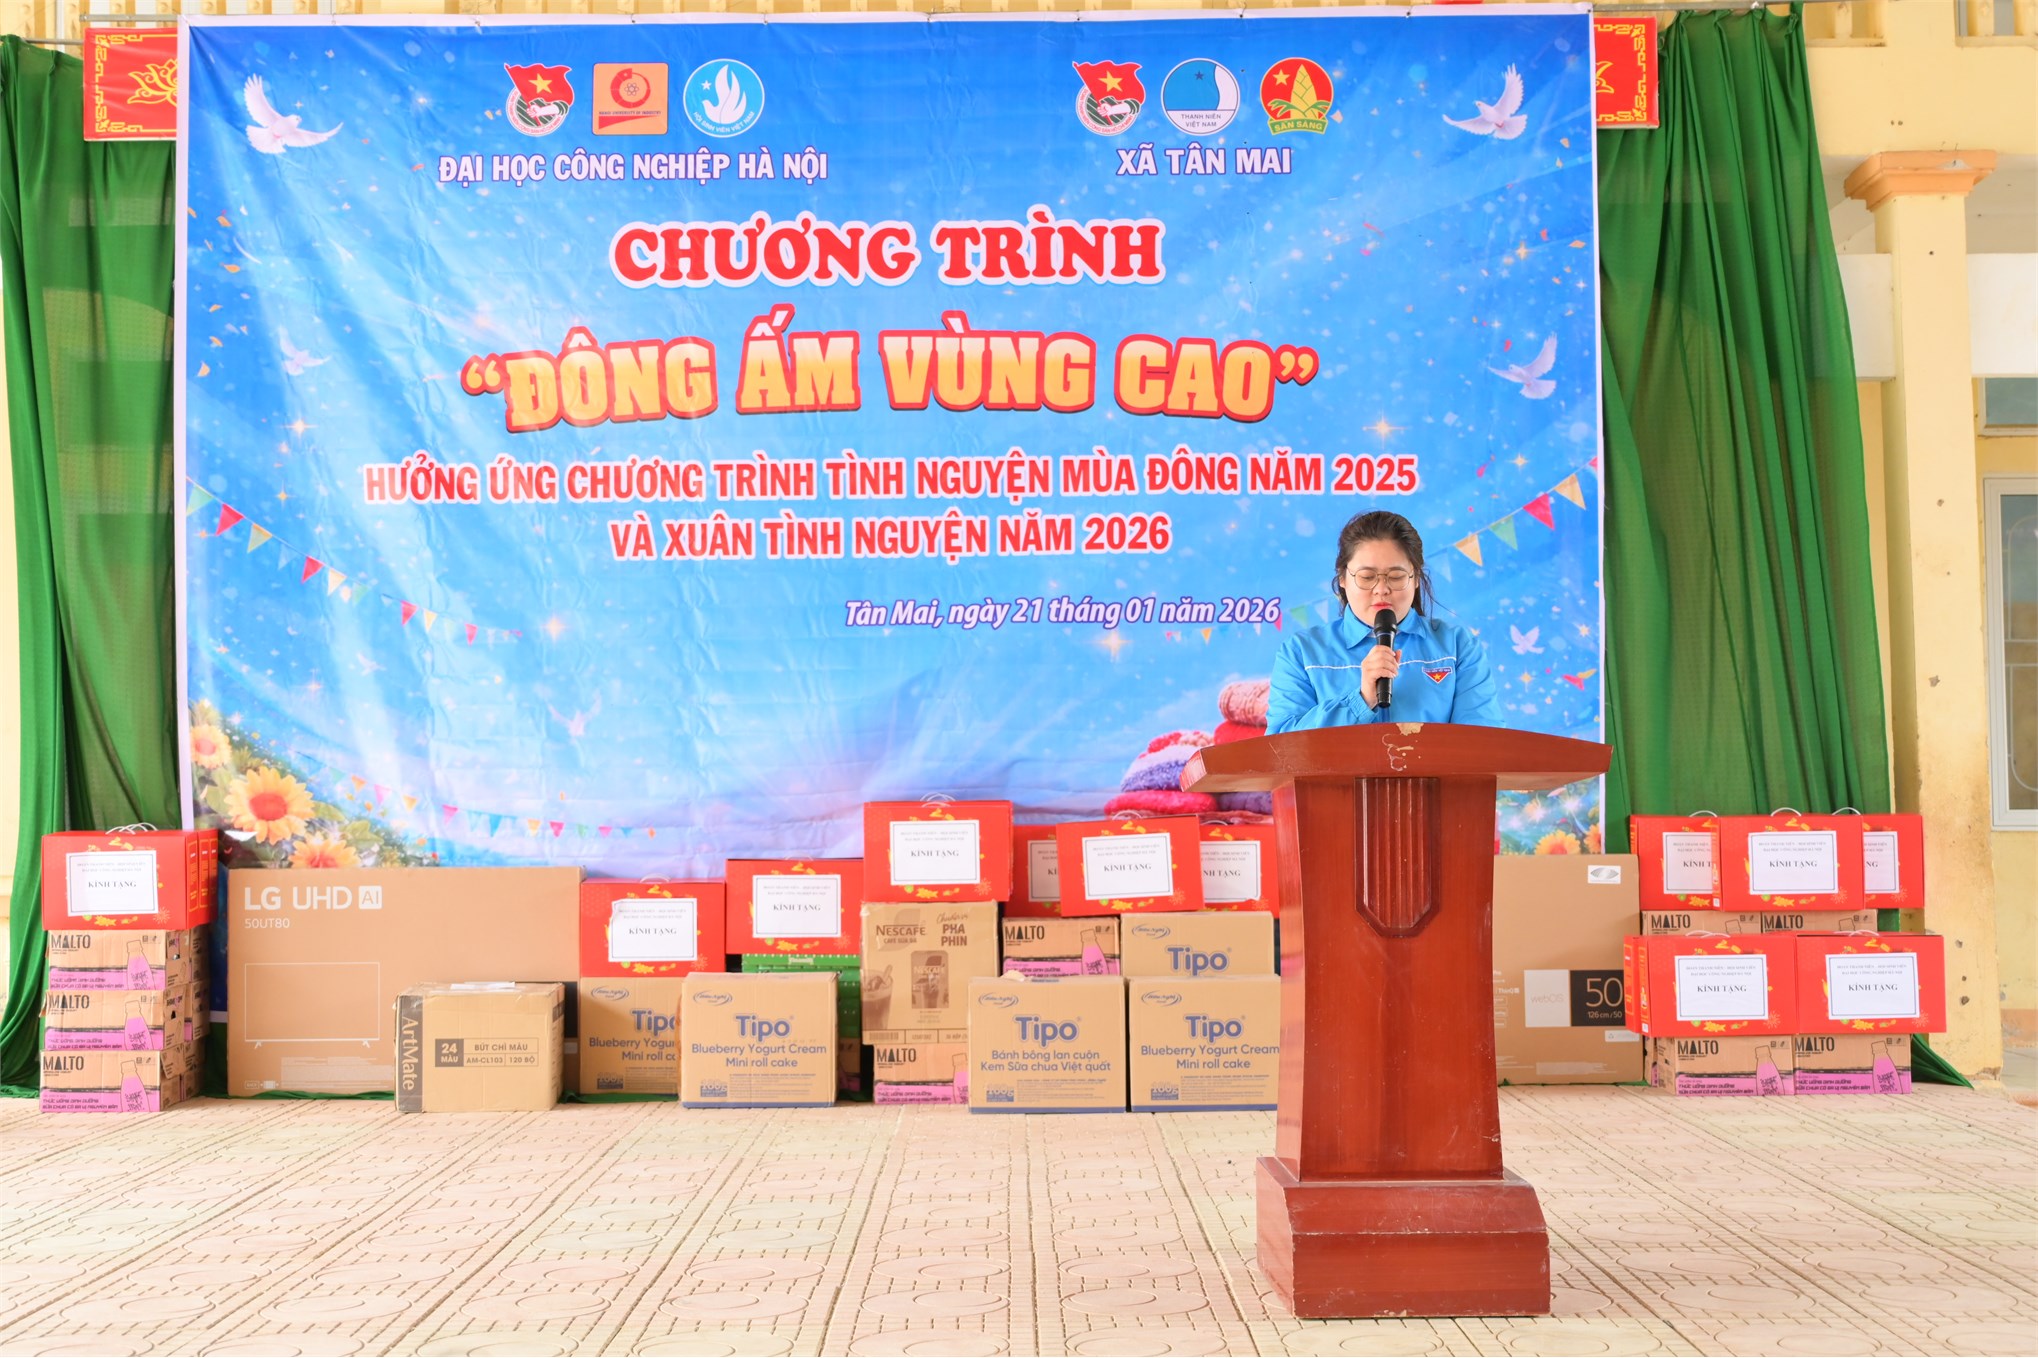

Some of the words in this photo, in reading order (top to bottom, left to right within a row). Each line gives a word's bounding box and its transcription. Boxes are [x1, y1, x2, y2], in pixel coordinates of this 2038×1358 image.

[1116, 142, 1158, 175] XÃ
[1165, 141, 1227, 175] TÂN
[1235, 147, 1292, 175] MAI
[439, 154, 483, 188] ĐẠI
[492, 154, 546, 187] HỌC
[553, 147, 625, 180] CÔNG
[633, 147, 731, 185] NGHIỆP
[738, 146, 775, 179] HÀ
[783, 145, 828, 184] NỘI
[612, 212, 917, 285] CHƯƠNG
[937, 206, 1164, 284] TRÌNH
[736, 305, 860, 414] ẤM
[879, 311, 1096, 414] VÙNG
[366, 452, 480, 504] HƯỞNG
[488, 454, 558, 503] ỨNG
[566, 456, 705, 502] CHƯƠNG
[712, 453, 816, 500] TRÌNH
[825, 450, 903, 499] TÌNH
[917, 446, 1054, 504] NGUYỆN
[1060, 446, 1137, 495] MÙA
[1145, 448, 1239, 494] ĐÔNG
[1248, 448, 1323, 493] NĂM
[1332, 455, 1417, 492] 2025
[609, 512, 655, 560] VÀ
[661, 512, 754, 560] XUÂN
[762, 509, 844, 560] TÌNH
[853, 506, 988, 565] NGUYỆN
[998, 508, 1073, 556] NĂM
[1083, 513, 1172, 556] 2026
[846, 600, 887, 626] Tân
[890, 599, 944, 628] Mai,
[948, 597, 1010, 629] ngày
[1011, 598, 1043, 622] 21
[1048, 596, 1121, 629] tháng
[1125, 598, 1156, 623] 01
[1159, 598, 1215, 623] năm
[1218, 598, 1280, 623] 2026
[244, 886, 281, 911] LG
[293, 886, 352, 910] UHD
[360, 888, 381, 906] AI
[244, 918, 290, 929] 50UT80
[942, 924, 966, 934] PHA
[1651, 914, 1691, 929] MALTO
[1764, 914, 1804, 929] MALTO
[1005, 925, 1045, 940] MALTO
[50, 934, 91, 949] MALTO
[940, 936, 968, 946] PHIN
[1166, 946, 1228, 976] Tipo
[1530, 993, 1564, 1004] webOS
[1585, 977, 1623, 1007] 50
[49, 992, 90, 1009] MALTO
[1587, 1011, 1599, 1019] 126
[736, 1014, 790, 1042] Tipo
[1015, 1016, 1078, 1047] Tipo
[1185, 1015, 1242, 1043] Tipo
[441, 1043, 458, 1053] 24
[474, 1042, 489, 1051] BÚT
[491, 1041, 507, 1051] CHÌ
[509, 1041, 528, 1051] MÀU
[589, 1037, 640, 1049] Blueberry
[692, 1043, 745, 1056] Blueberry
[748, 1043, 785, 1056] Yogurt
[788, 1043, 827, 1054] Cream
[1141, 1045, 1196, 1057] Blueberry
[1199, 1045, 1238, 1057] Yogurt
[1241, 1044, 1280, 1055] Cream
[1677, 1040, 1719, 1055] MALTO
[1795, 1037, 1835, 1052] MALTO
[402, 1016, 419, 1090] ArtMate
[524, 1056, 535, 1064] BỘ
[622, 1051, 644, 1061] Mini
[646, 1051, 663, 1061] roll
[877, 1048, 917, 1062] MALTO
[992, 1050, 1019, 1060] Bánh
[1022, 1050, 1050, 1061] bông
[1053, 1050, 1070, 1059] lan
[1073, 1050, 1100, 1062] cuộn
[43, 1055, 84, 1070] MALTO
[726, 1057, 748, 1067] Mini
[751, 1057, 768, 1067] roll
[771, 1057, 798, 1067] cake
[981, 1061, 1005, 1071] Kem
[1008, 1061, 1028, 1071] Sữa
[1031, 1061, 1058, 1071] chua
[1060, 1061, 1082, 1073] Việt
[1085, 1060, 1111, 1072] quất
[1176, 1059, 1199, 1069] Mini
[1202, 1058, 1220, 1069] roll
[1222, 1058, 1251, 1069] cake
